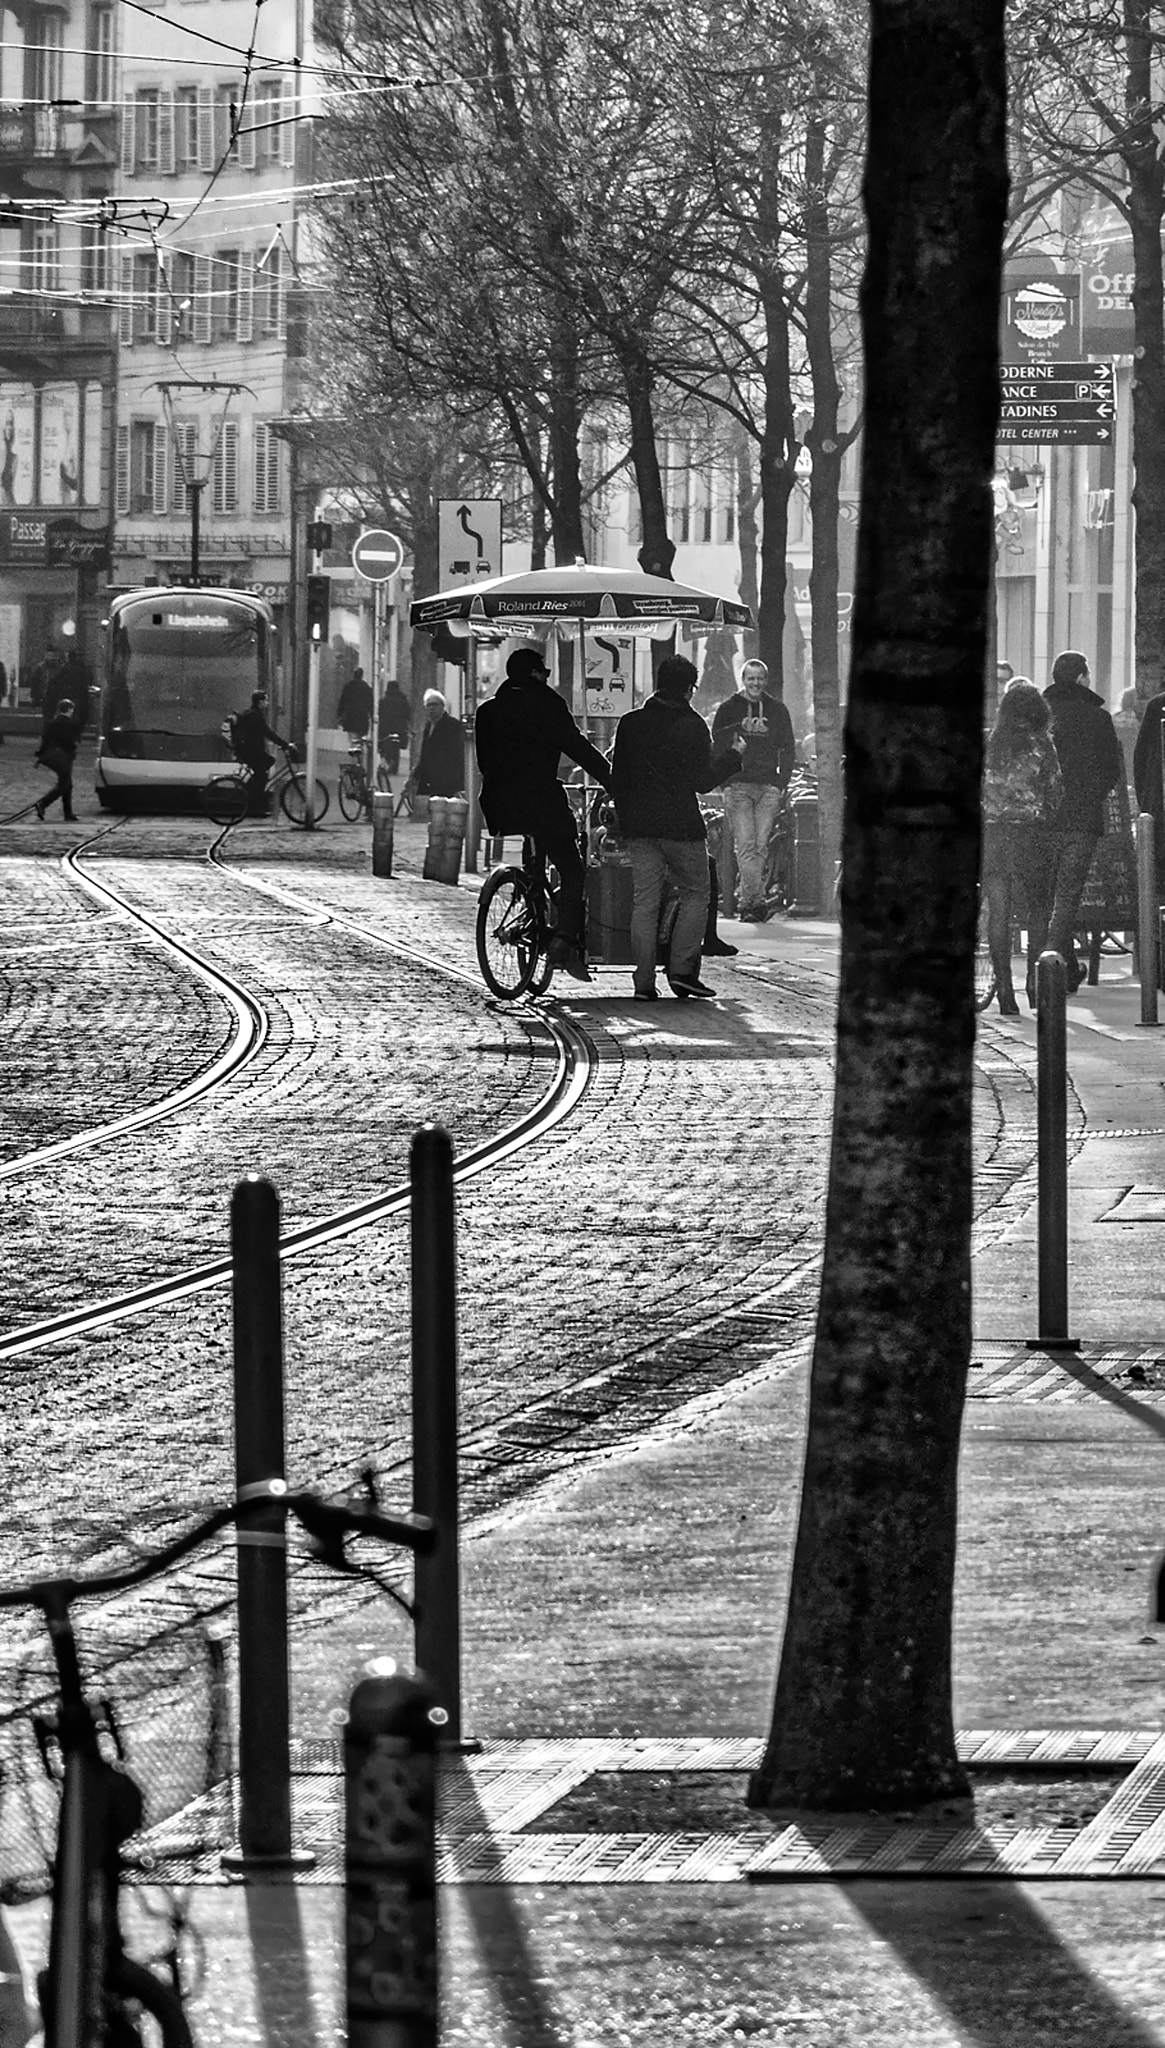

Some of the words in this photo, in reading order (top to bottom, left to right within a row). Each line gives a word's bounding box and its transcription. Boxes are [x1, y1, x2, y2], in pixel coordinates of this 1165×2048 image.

[349, 201, 366, 212] 15
[1021, 428, 1060, 439] CENTER
[498, 601, 541, 611] Roland
[541, 600, 569, 610] Ries
